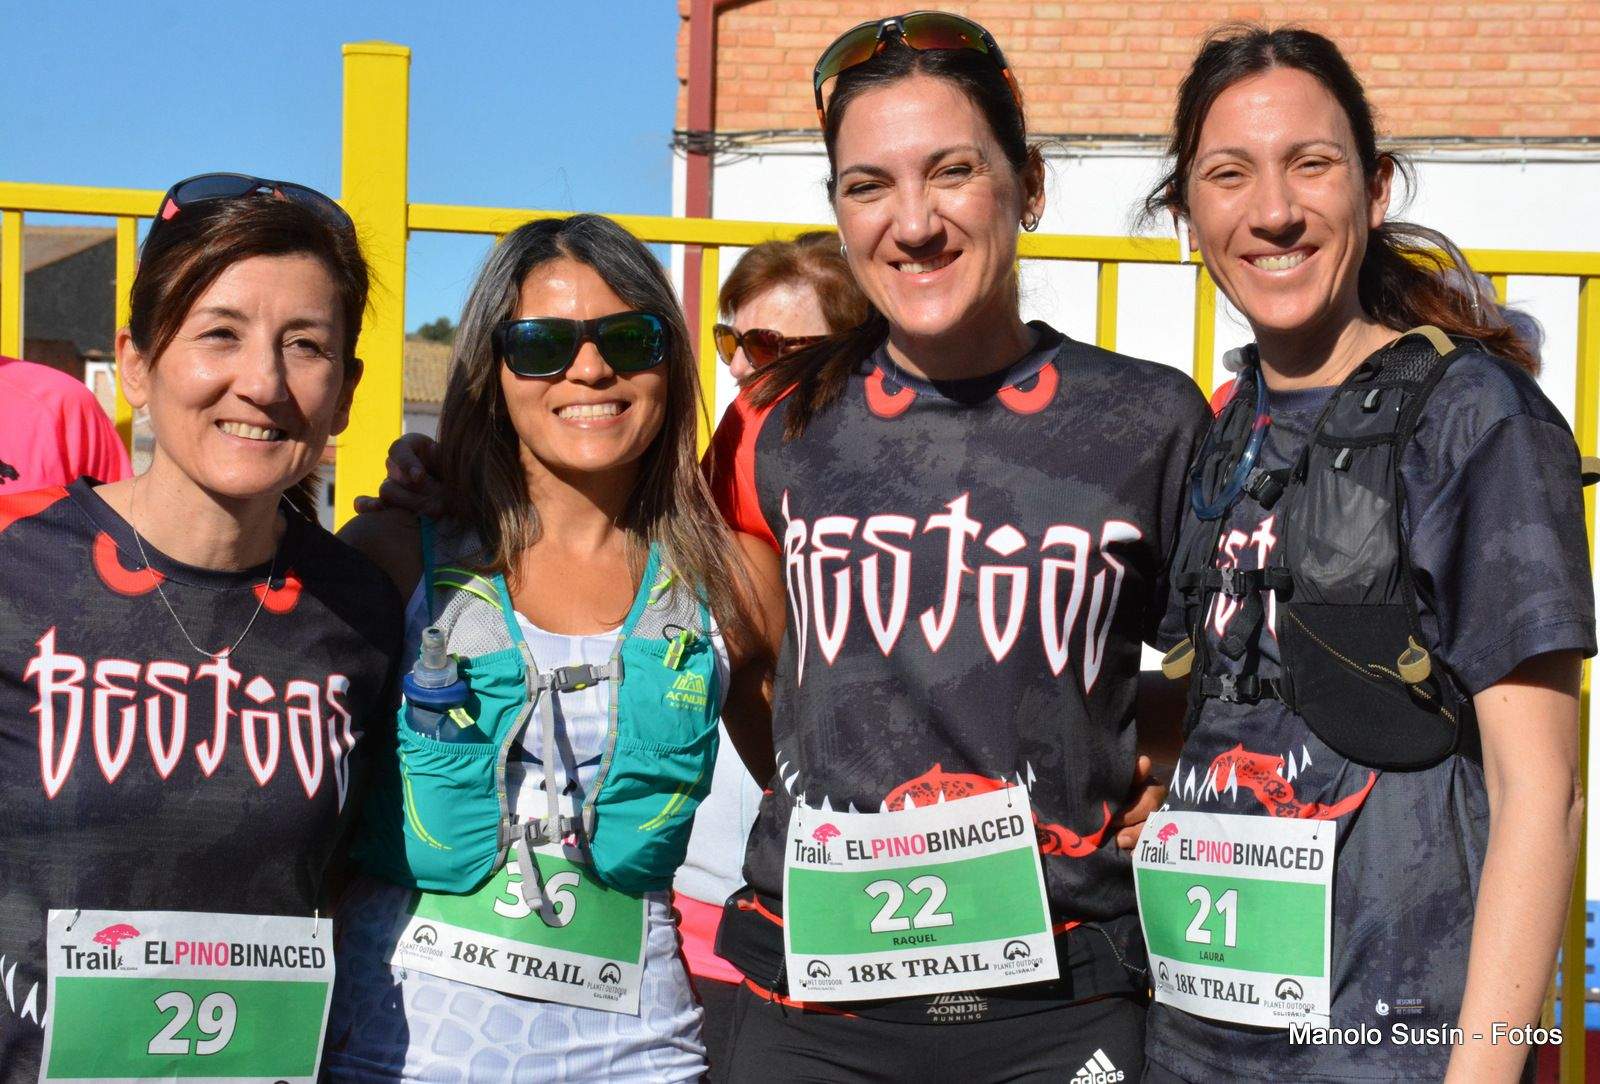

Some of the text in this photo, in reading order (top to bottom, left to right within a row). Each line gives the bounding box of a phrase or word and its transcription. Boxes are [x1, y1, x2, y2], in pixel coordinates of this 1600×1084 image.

[793, 838, 828, 865] Trail
[1140, 840, 1166, 865] Trail
[863, 874, 955, 934] 22
[1185, 884, 1240, 948] 21
[893, 933, 937, 946] RAQUEL
[60, 944, 118, 971] Trail
[450, 940, 585, 987] 18K TRAIL
[847, 953, 990, 984] 18K TRAIL
[1199, 950, 1225, 963] LAURA
[1174, 972, 1198, 996] 18K
[1201, 976, 1261, 1006] TRAIL
[146, 990, 239, 1056] 29
[926, 1003, 988, 1015] AONIJIE
